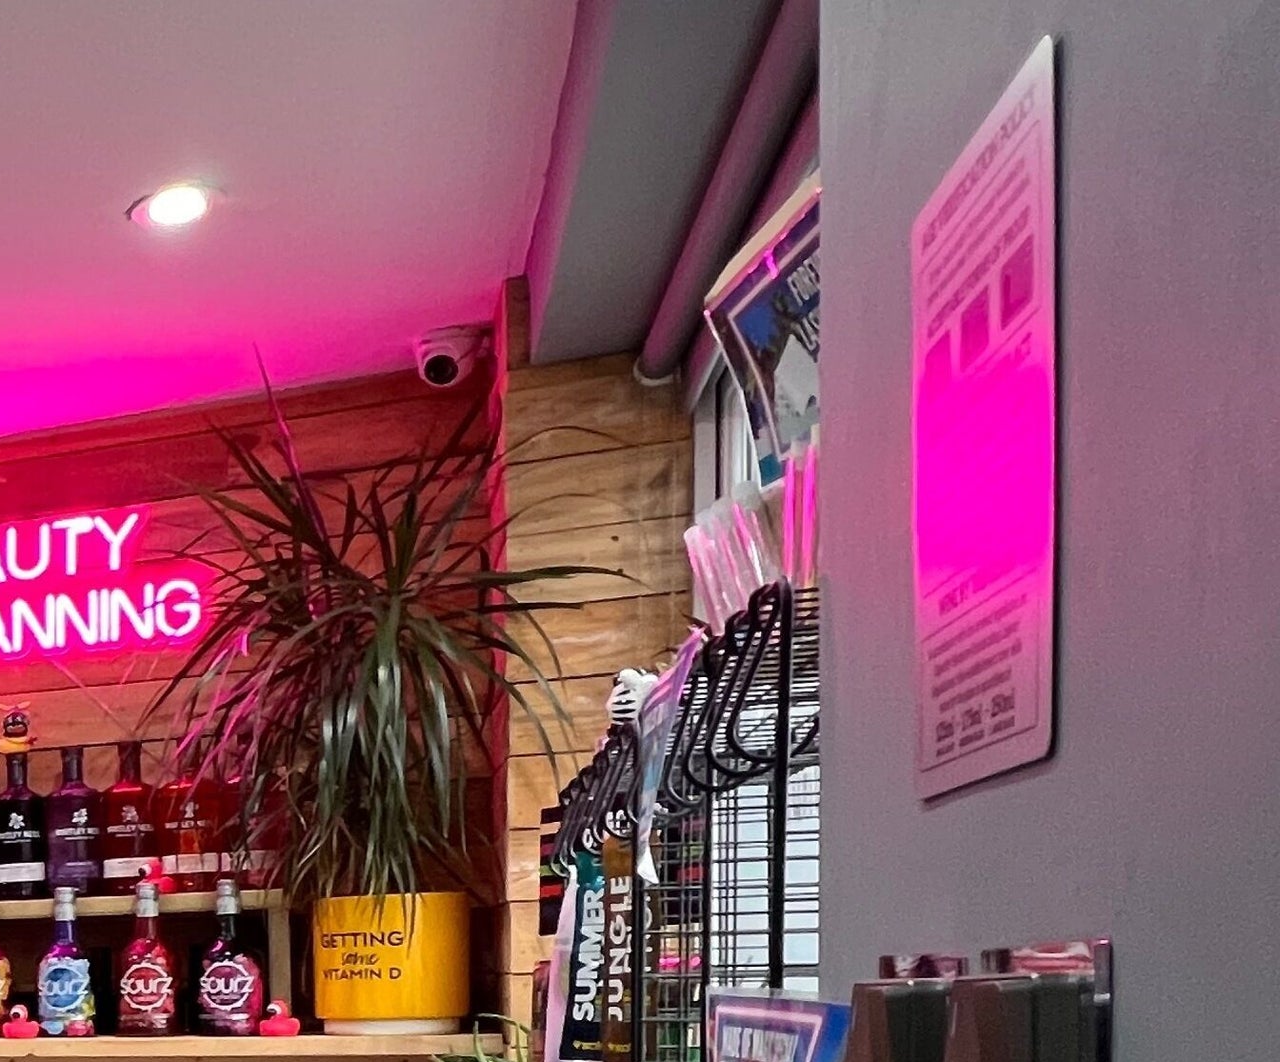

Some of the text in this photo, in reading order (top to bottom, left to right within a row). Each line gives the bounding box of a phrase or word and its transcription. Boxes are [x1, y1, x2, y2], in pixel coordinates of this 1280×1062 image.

[321, 931, 404, 949] GETTING
[323, 967, 402, 980] VITAMIN D
[572, 889, 605, 1022] SUMMER
[608, 876, 633, 1022] JUNGLE
